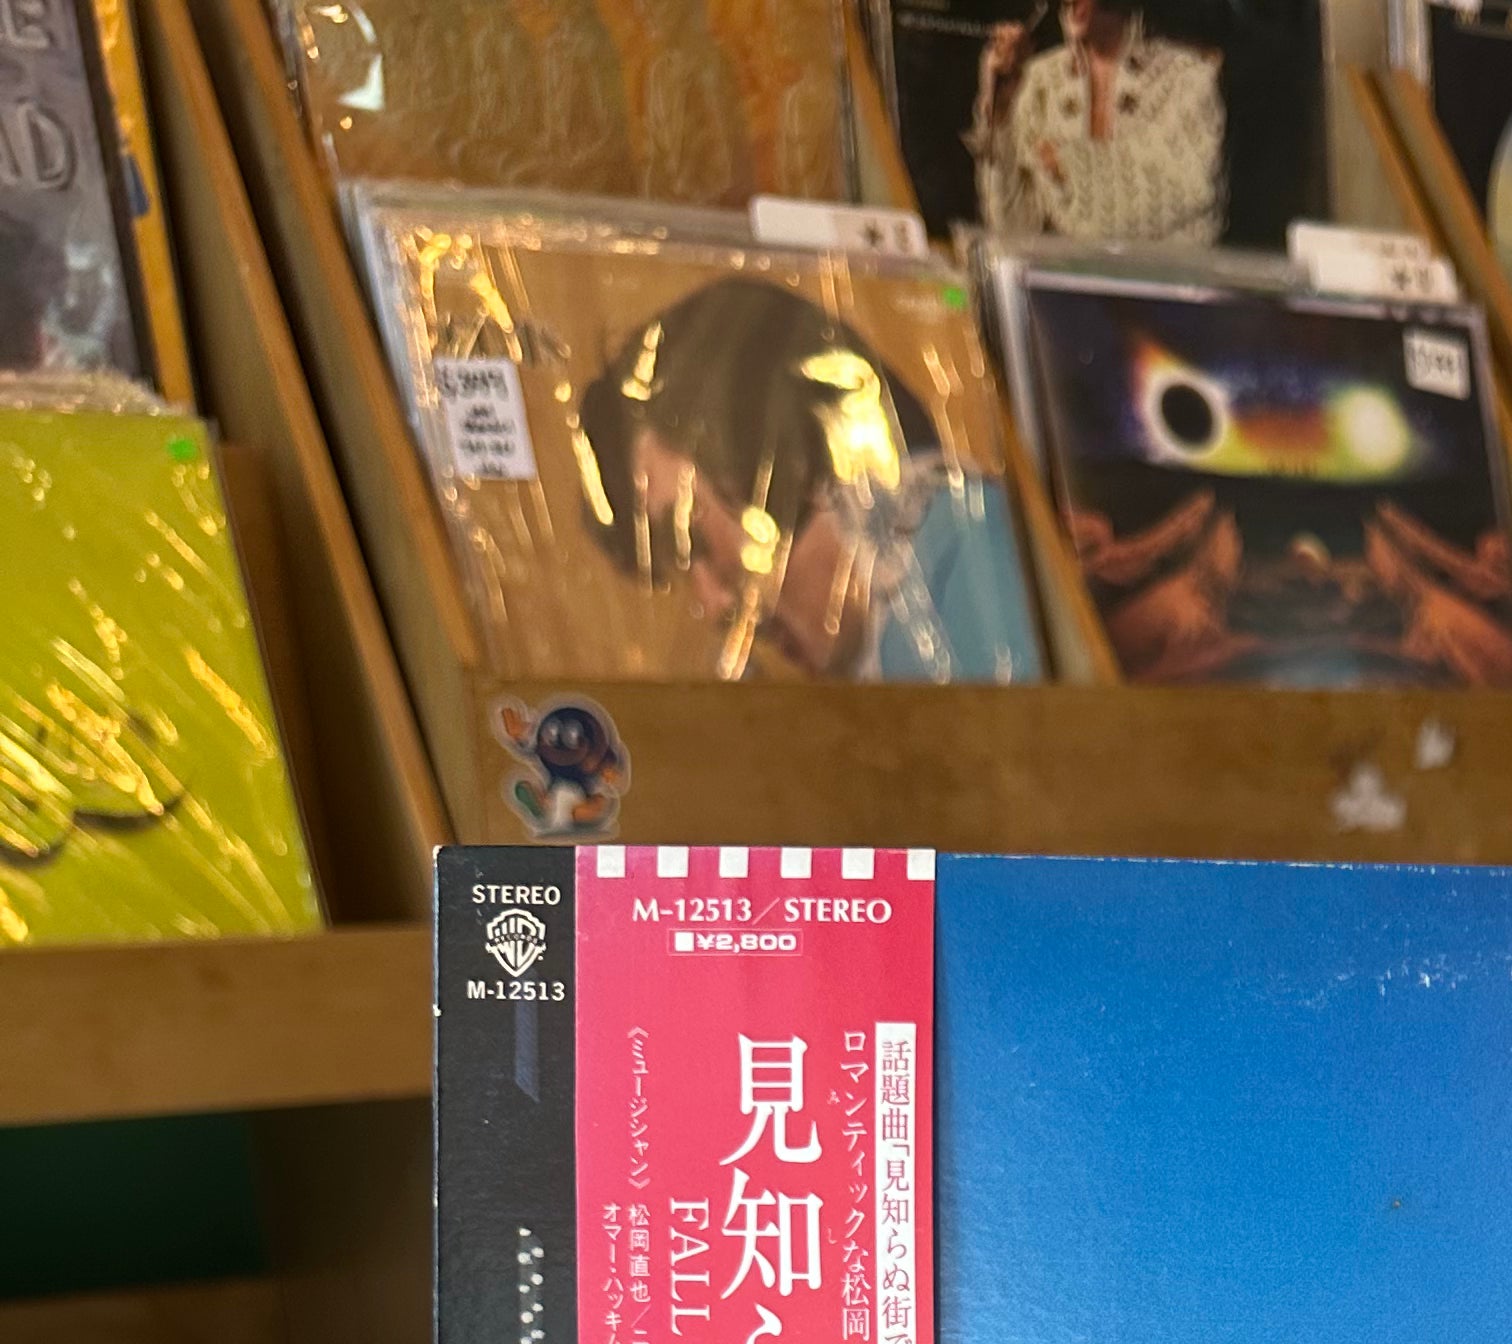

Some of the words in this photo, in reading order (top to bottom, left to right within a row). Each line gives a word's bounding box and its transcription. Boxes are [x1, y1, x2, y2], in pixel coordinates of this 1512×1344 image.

[471, 884, 561, 906] STEREO
[466, 981, 566, 1002] M-12513
[669, 1197, 711, 1337] FALL
